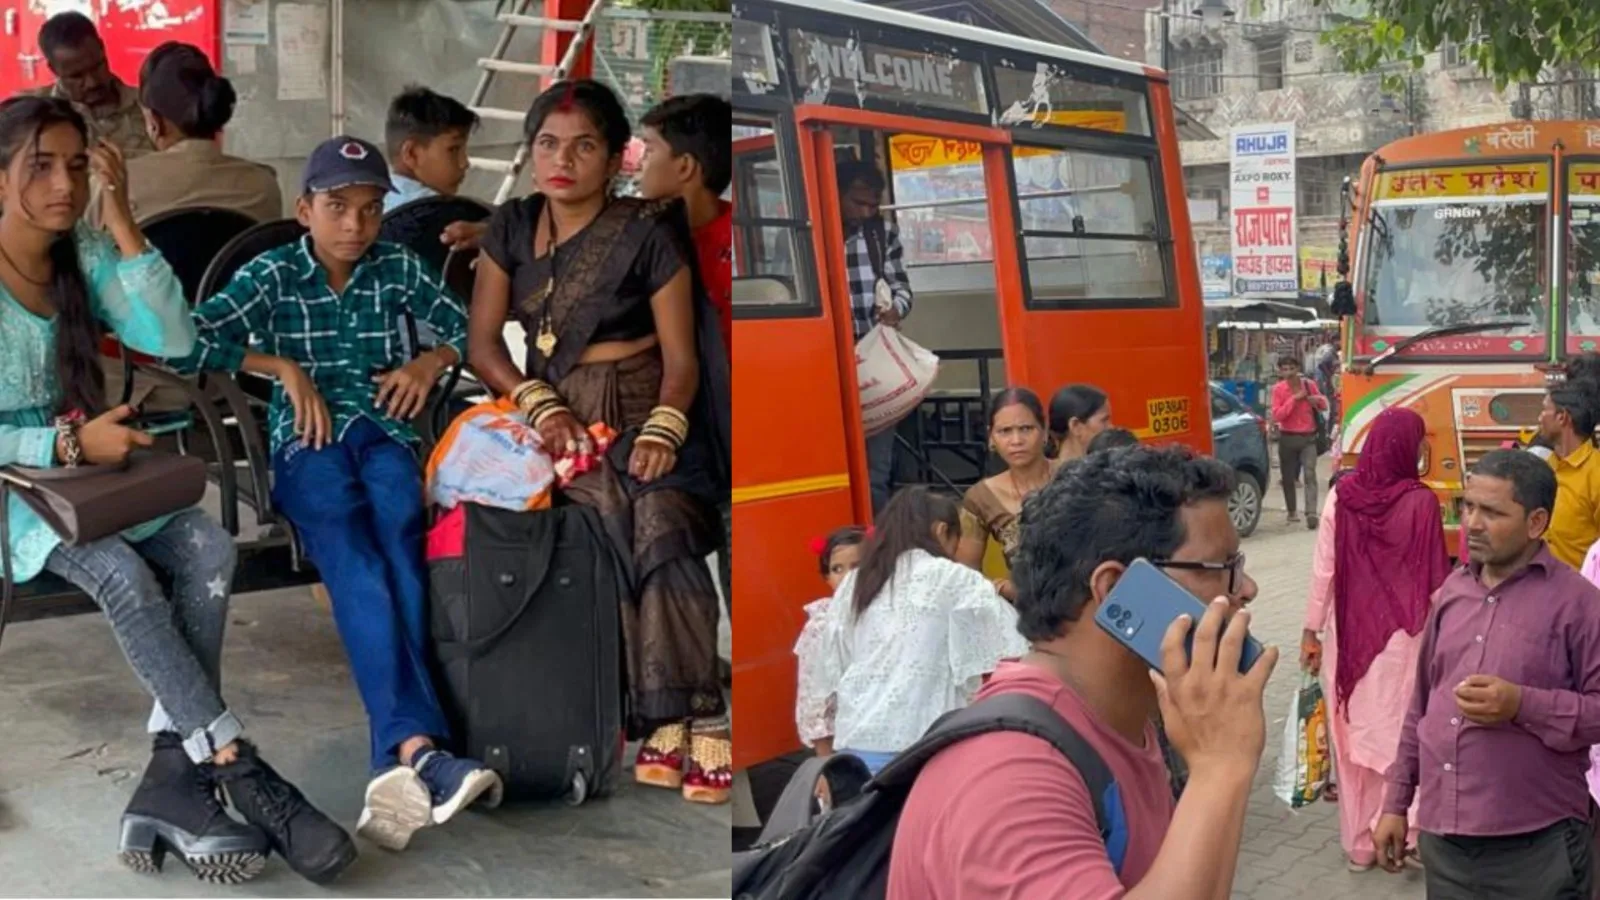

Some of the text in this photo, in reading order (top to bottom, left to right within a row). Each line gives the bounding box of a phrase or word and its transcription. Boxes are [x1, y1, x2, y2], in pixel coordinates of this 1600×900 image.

[814, 40, 953, 96] WELCOME
[1236, 135, 1287, 153] AHUJA
[1485, 124, 1540, 149] बरेली
[1391, 165, 1541, 193] उत्तर प्रदेश
[1234, 207, 1293, 247] राजपाल
[1236, 248, 1262, 276] साउंड
[1265, 254, 1293, 275] हाउस
[1153, 414, 1188, 433] 0306
